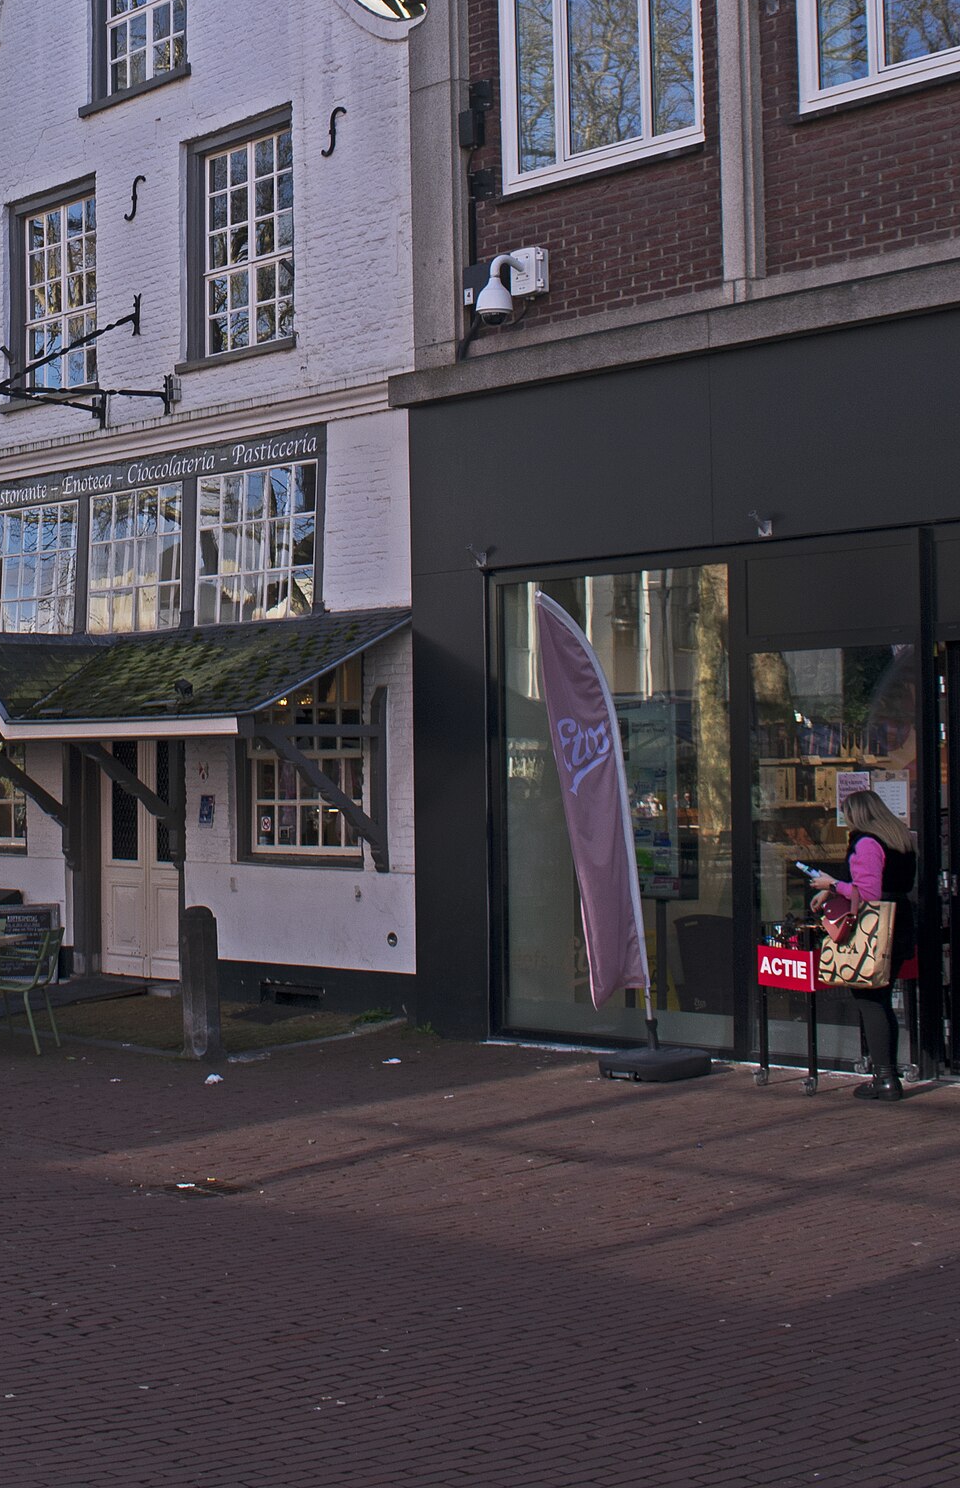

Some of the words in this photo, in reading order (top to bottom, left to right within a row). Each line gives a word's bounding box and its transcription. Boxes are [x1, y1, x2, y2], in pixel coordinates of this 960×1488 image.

[62, 474, 112, 496] Enoteca
[127, 451, 216, 485] Cioccolateria
[232, 432, 318, 466] Pasticceria
[760, 956, 807, 980] ACTIE
